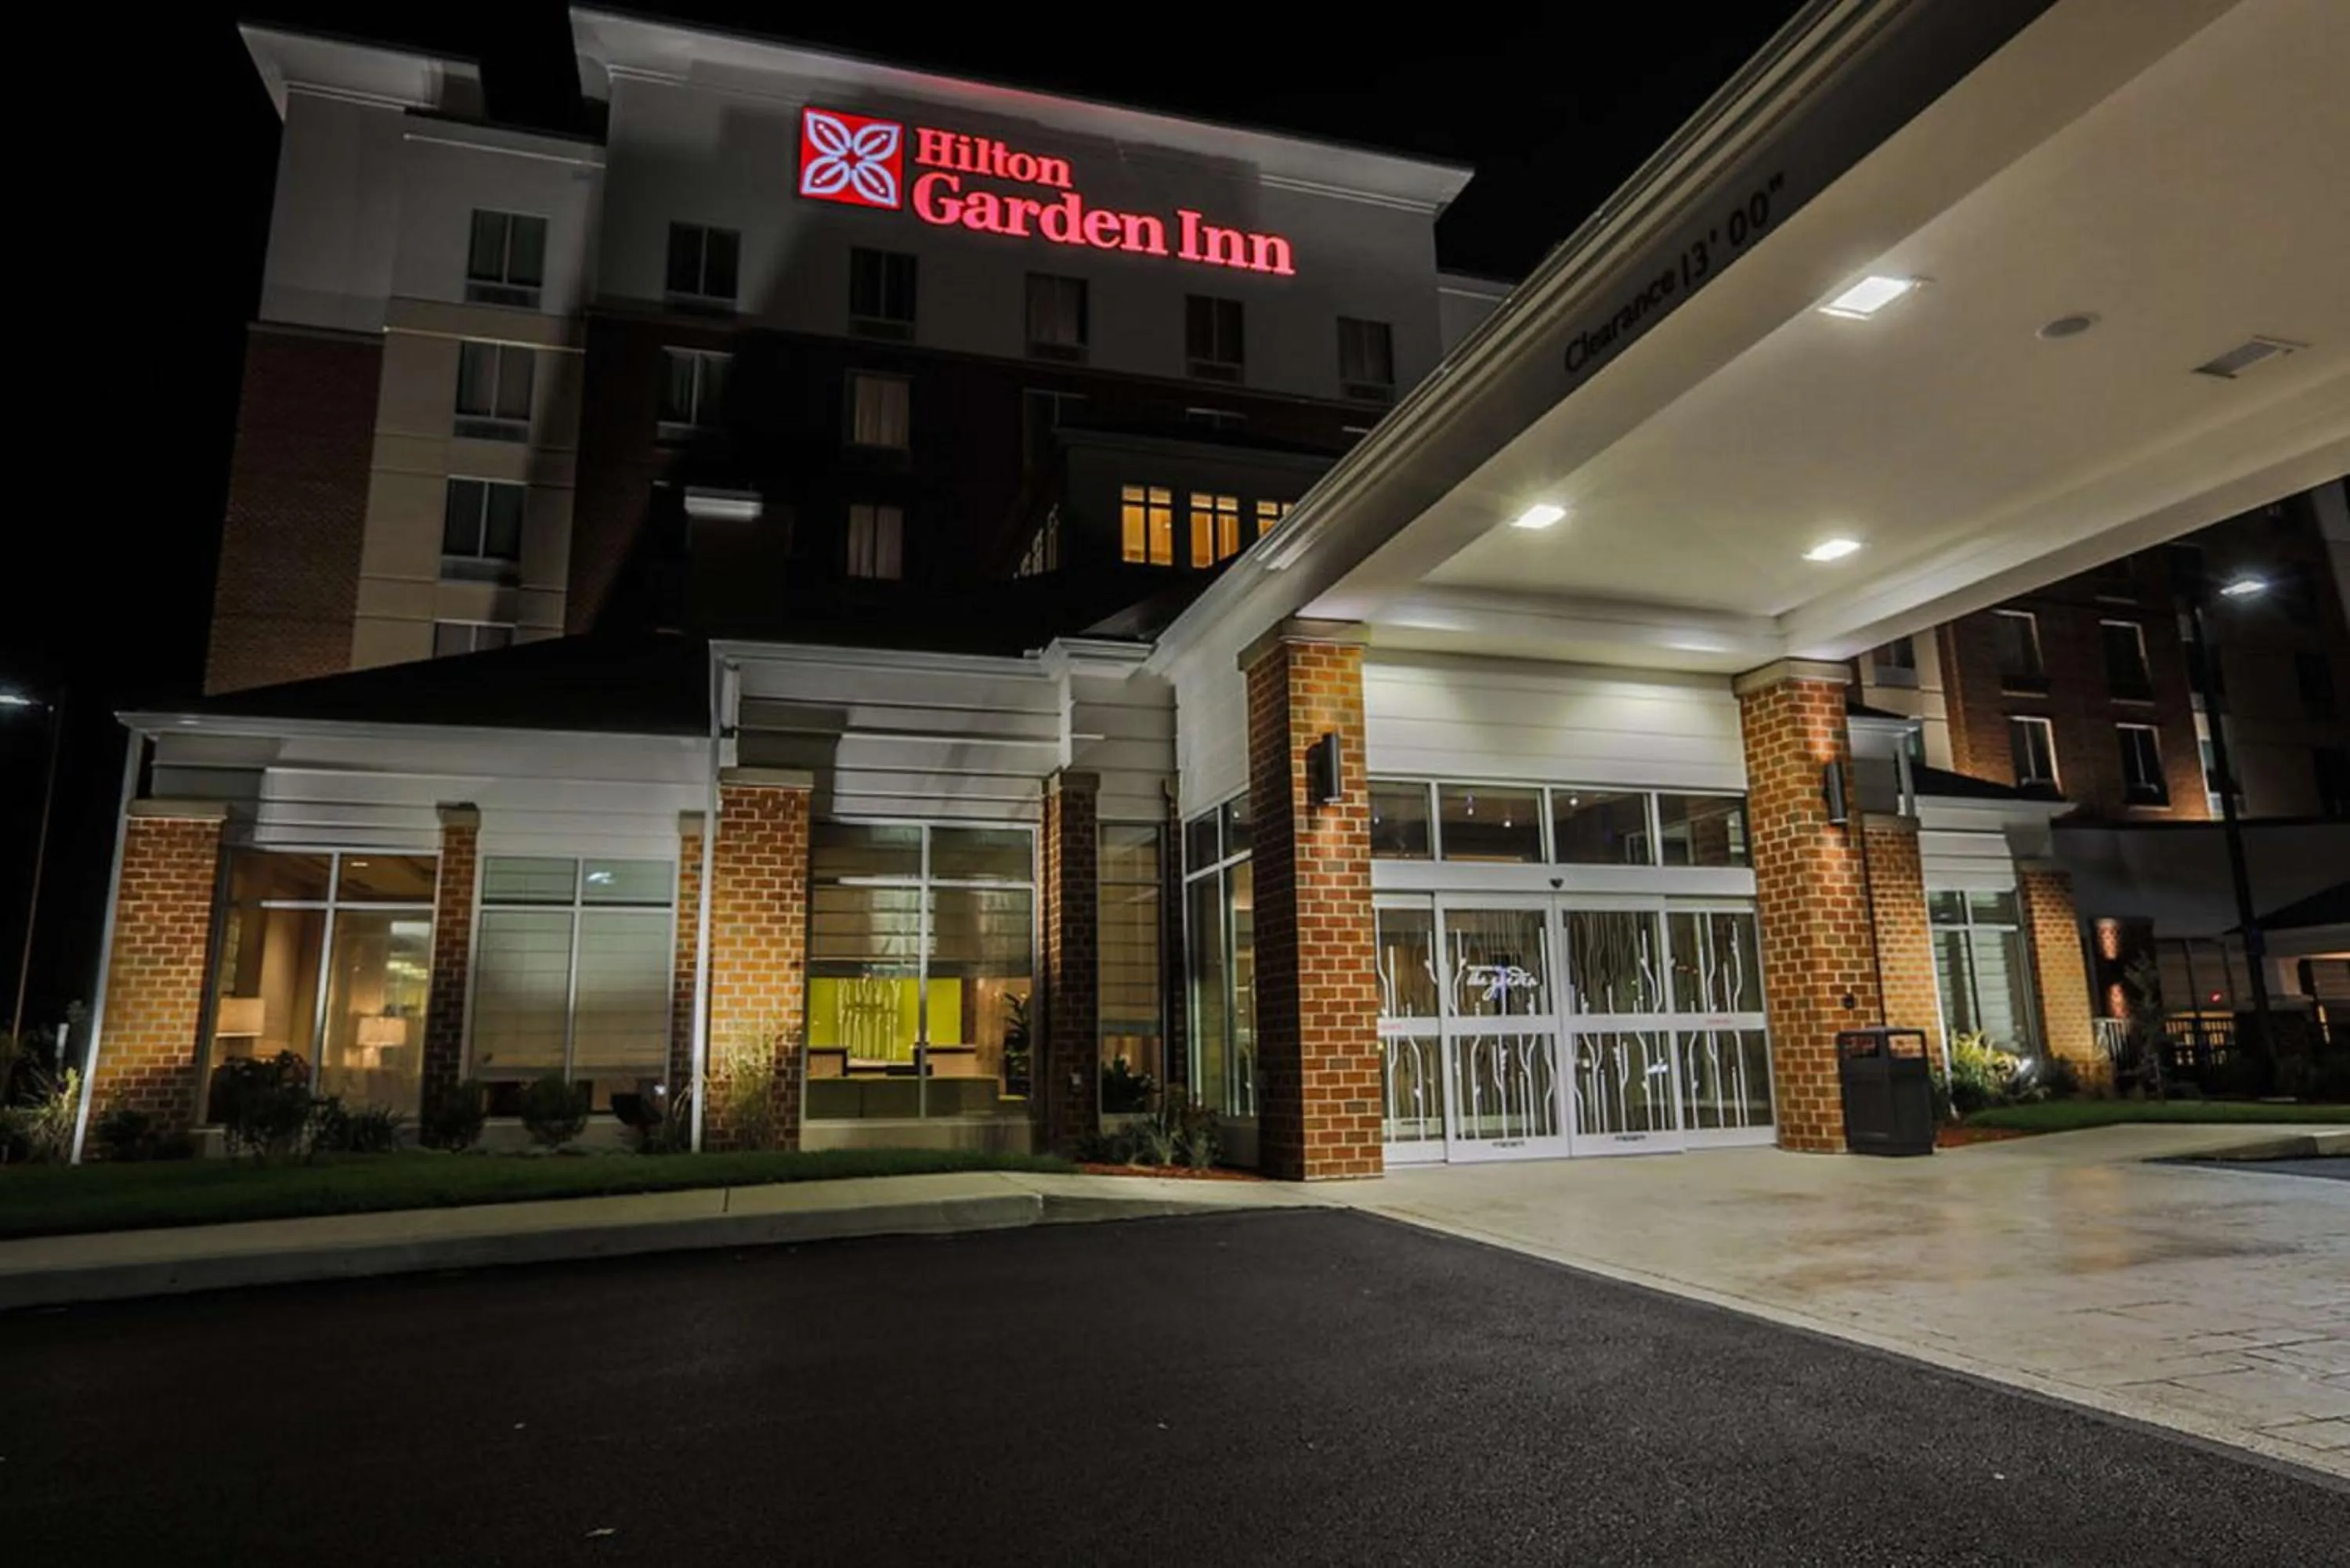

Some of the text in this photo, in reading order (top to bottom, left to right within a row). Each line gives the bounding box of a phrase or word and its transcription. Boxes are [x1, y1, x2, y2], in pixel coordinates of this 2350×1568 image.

[916, 129, 1072, 188] Hilton
[913, 173, 1295, 275] Garden Inn
[1565, 269, 1675, 371] Clearance
